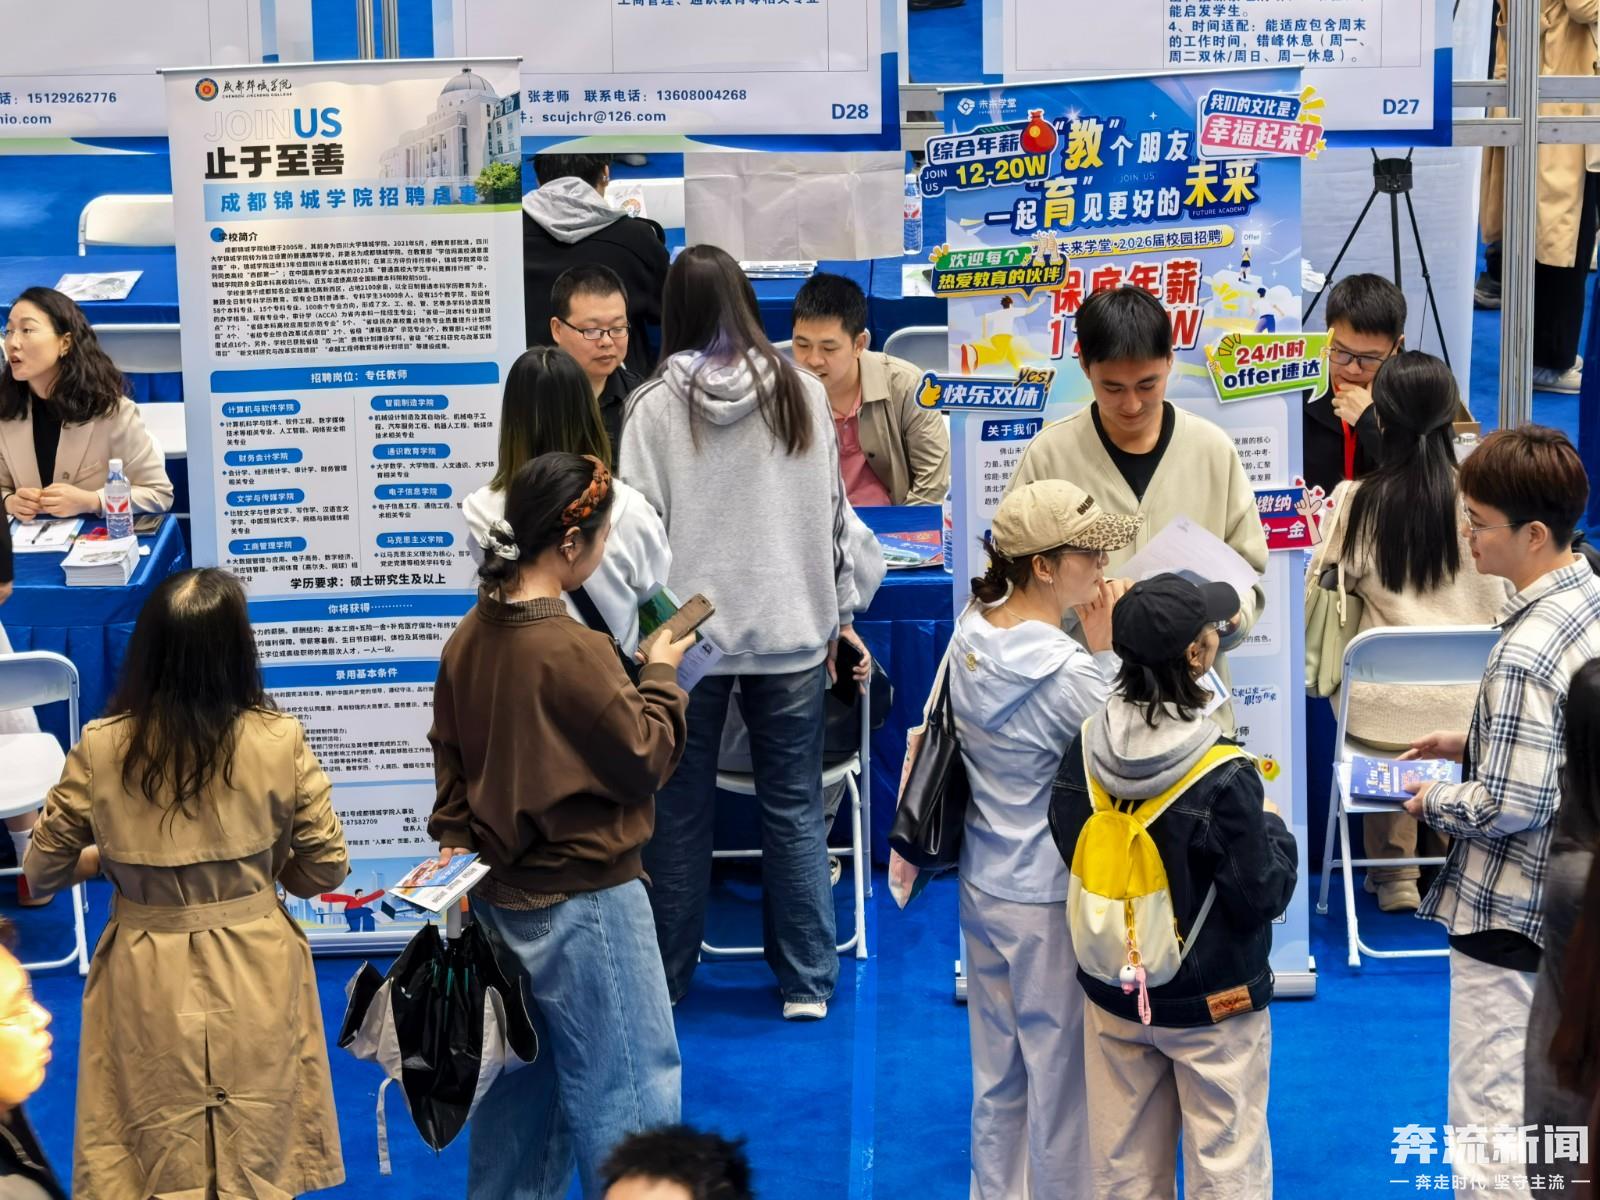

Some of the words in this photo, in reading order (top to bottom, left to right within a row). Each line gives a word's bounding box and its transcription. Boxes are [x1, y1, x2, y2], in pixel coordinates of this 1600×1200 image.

[1169, 5, 1249, 18] 能启发学生。
[831, 103, 869, 120] D28
[1382, 98, 1420, 115] D27
[204, 108, 292, 143] JOIN
[293, 107, 342, 139] US
[932, 133, 1020, 160] 综合年薪
[205, 143, 345, 180] 止于至善
[924, 169, 948, 180] JOIN
[956, 154, 1047, 185] 12-20W
[925, 182, 939, 192] US
[220, 185, 480, 213] 成都锦城学院招聘启事
[1192, 208, 1217, 217] FUTURE
[1218, 205, 1247, 215] ACADEMY
[949, 248, 1020, 268] 欢迎每个
[938, 266, 1061, 290] 热爱教育的伙伴
[1235, 339, 1306, 366] 24小时
[1223, 359, 1320, 389] offer速达
[943, 384, 1040, 406] 快乐双休
[228, 403, 295, 414] 计算机与软件学院
[988, 423, 1038, 437] 关于我们
[238, 452, 289, 463] 财务会计学院
[387, 446, 437, 455] 通识教育学院
[237, 492, 294, 503] 文学与传媒学院
[388, 487, 438, 496] 电子信息学院
[243, 540, 293, 551] 工商管理学院
[387, 535, 444, 545] 马克思主义学院
[336, 668, 398, 681] 录用基本条件
